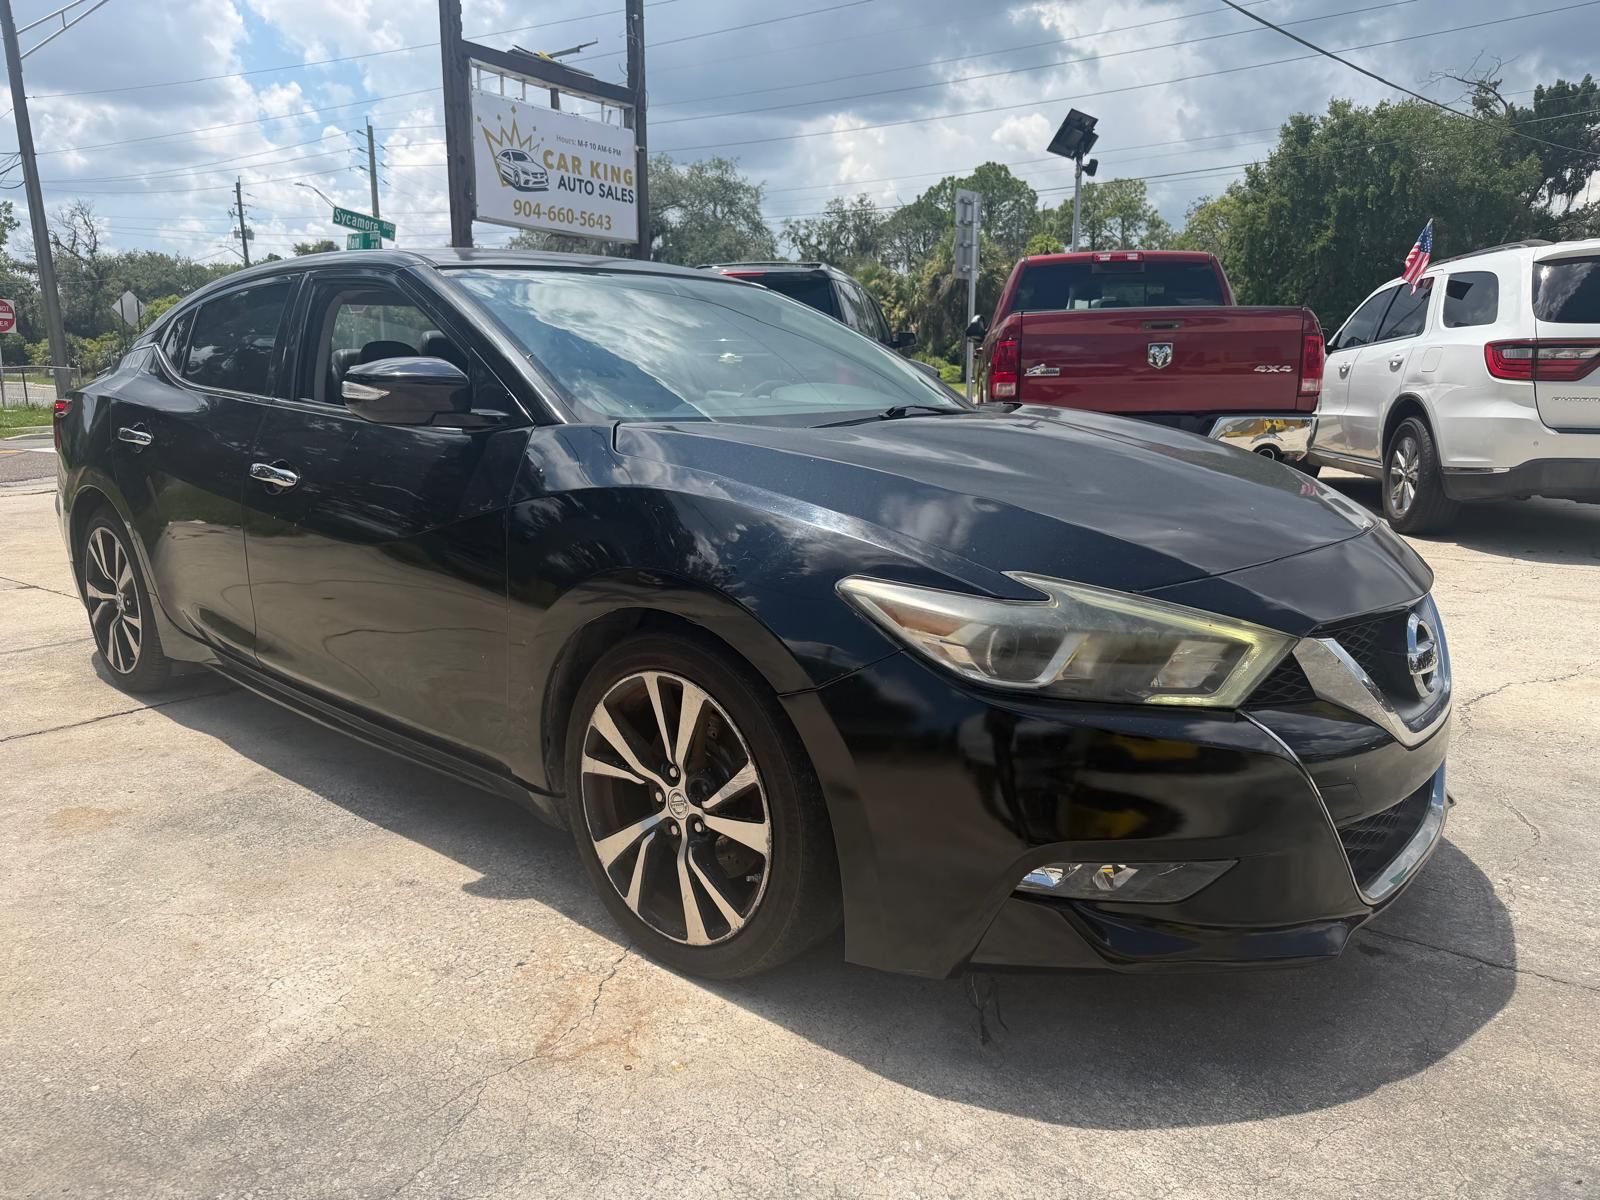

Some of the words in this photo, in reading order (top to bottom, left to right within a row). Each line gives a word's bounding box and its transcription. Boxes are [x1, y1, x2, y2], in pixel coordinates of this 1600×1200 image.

[543, 149, 582, 176] CAR
[590, 161, 633, 186] KING
[612, 148, 622, 157] PM
[557, 175, 594, 196] AUTO
[598, 183, 634, 205] SALES
[334, 208, 379, 231] Sycamore
[513, 200, 612, 230] 904-660-5643
